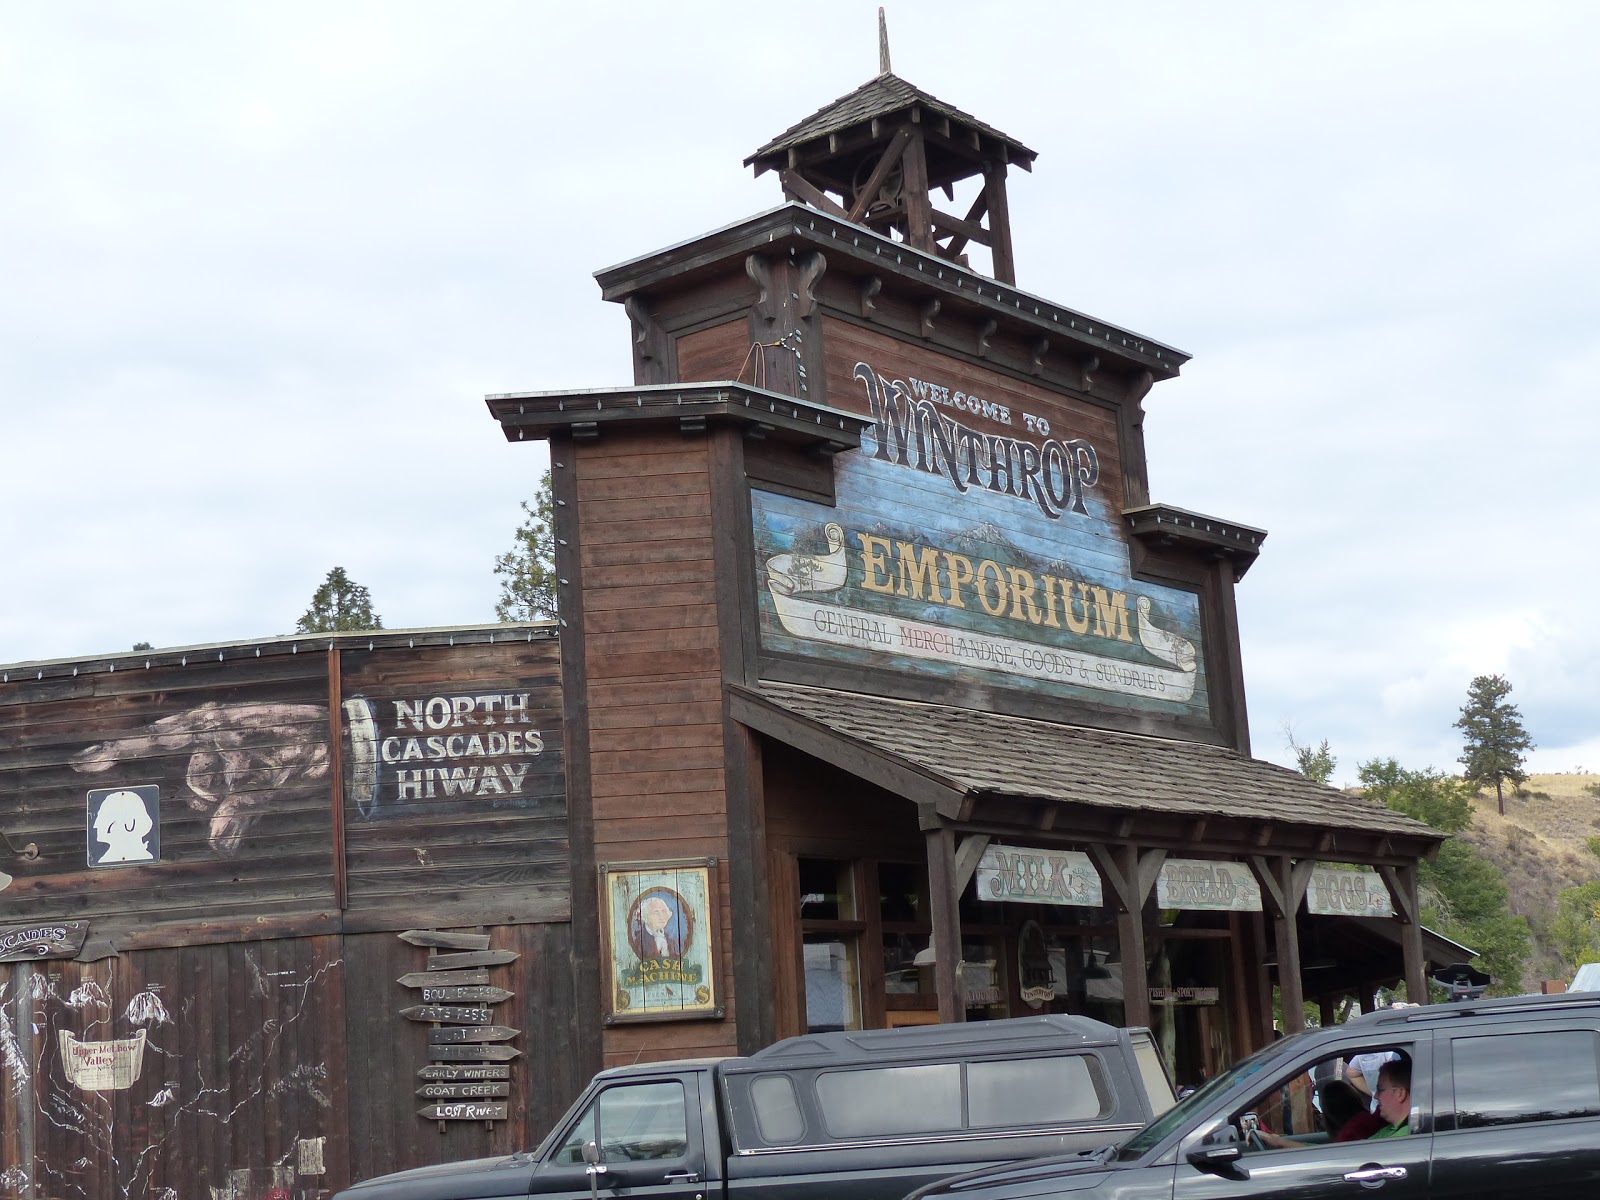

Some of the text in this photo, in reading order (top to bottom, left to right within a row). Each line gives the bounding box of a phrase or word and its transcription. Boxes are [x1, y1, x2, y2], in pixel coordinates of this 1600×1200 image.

[909, 377, 1050, 436] WELCOME TO
[853, 361, 1099, 520] WINTHROP
[857, 532, 1133, 643] EMPORIUM
[814, 609, 892, 645] GENERAL
[900, 626, 1017, 669] MERCHANDISE,
[1022, 647, 1073, 676] GOODS
[1096, 663, 1166, 692] SUNDRIES
[392, 693, 532, 732] NORTH
[381, 729, 544, 764] CASCADES
[396, 762, 532, 800] HIWAY
[990, 852, 1072, 899] MILK
[625, 971, 698, 985] MACHINE
[639, 959, 685, 972] CASH
[72, 1047, 97, 1057] Upper
[83, 1056, 115, 1066] Valley
[426, 1068, 506, 1079] EARLY WINTERS
[426, 1085, 500, 1096] GOAT CREEK
[436, 1104, 466, 1117] LOST
